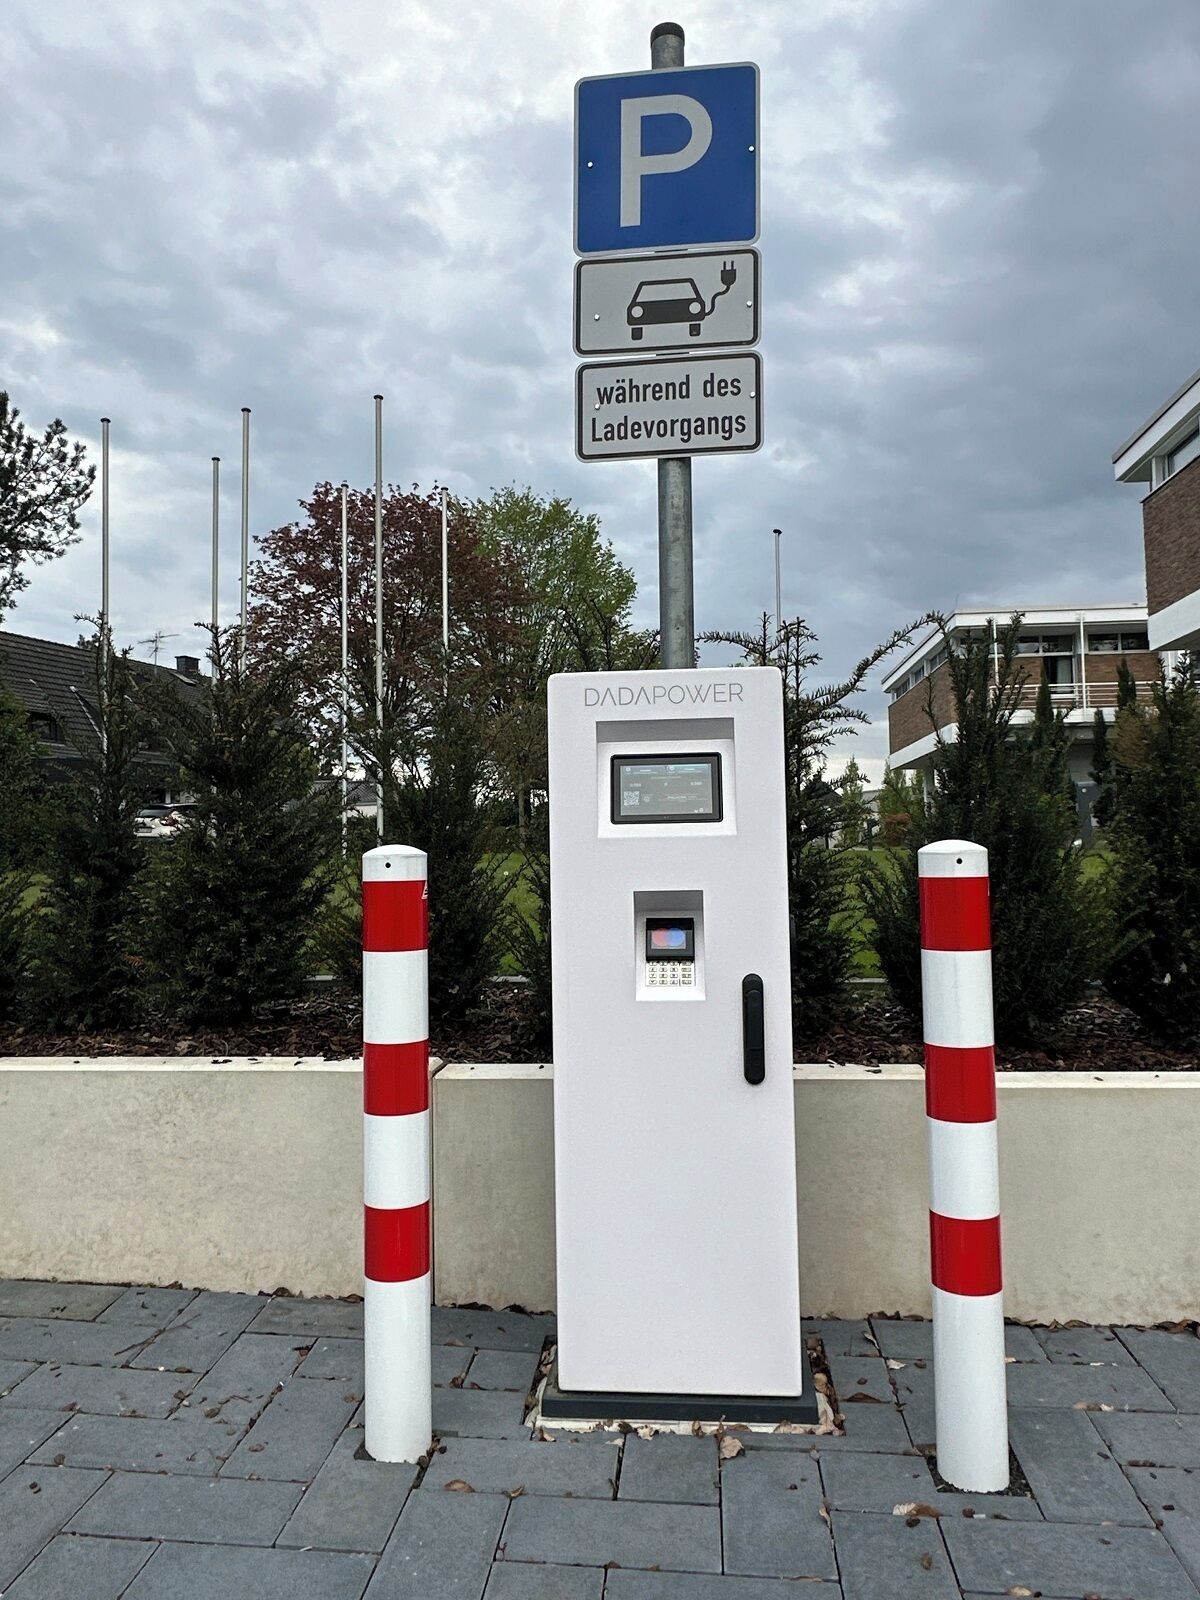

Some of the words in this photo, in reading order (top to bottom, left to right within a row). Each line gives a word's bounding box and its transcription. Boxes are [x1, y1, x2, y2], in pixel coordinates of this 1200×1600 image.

[620, 93, 713, 228] P
[596, 374, 690, 405] während
[703, 372, 742, 398] des
[591, 415, 746, 443] Ladevorgangs
[584, 682, 744, 707] DADAPOWER
